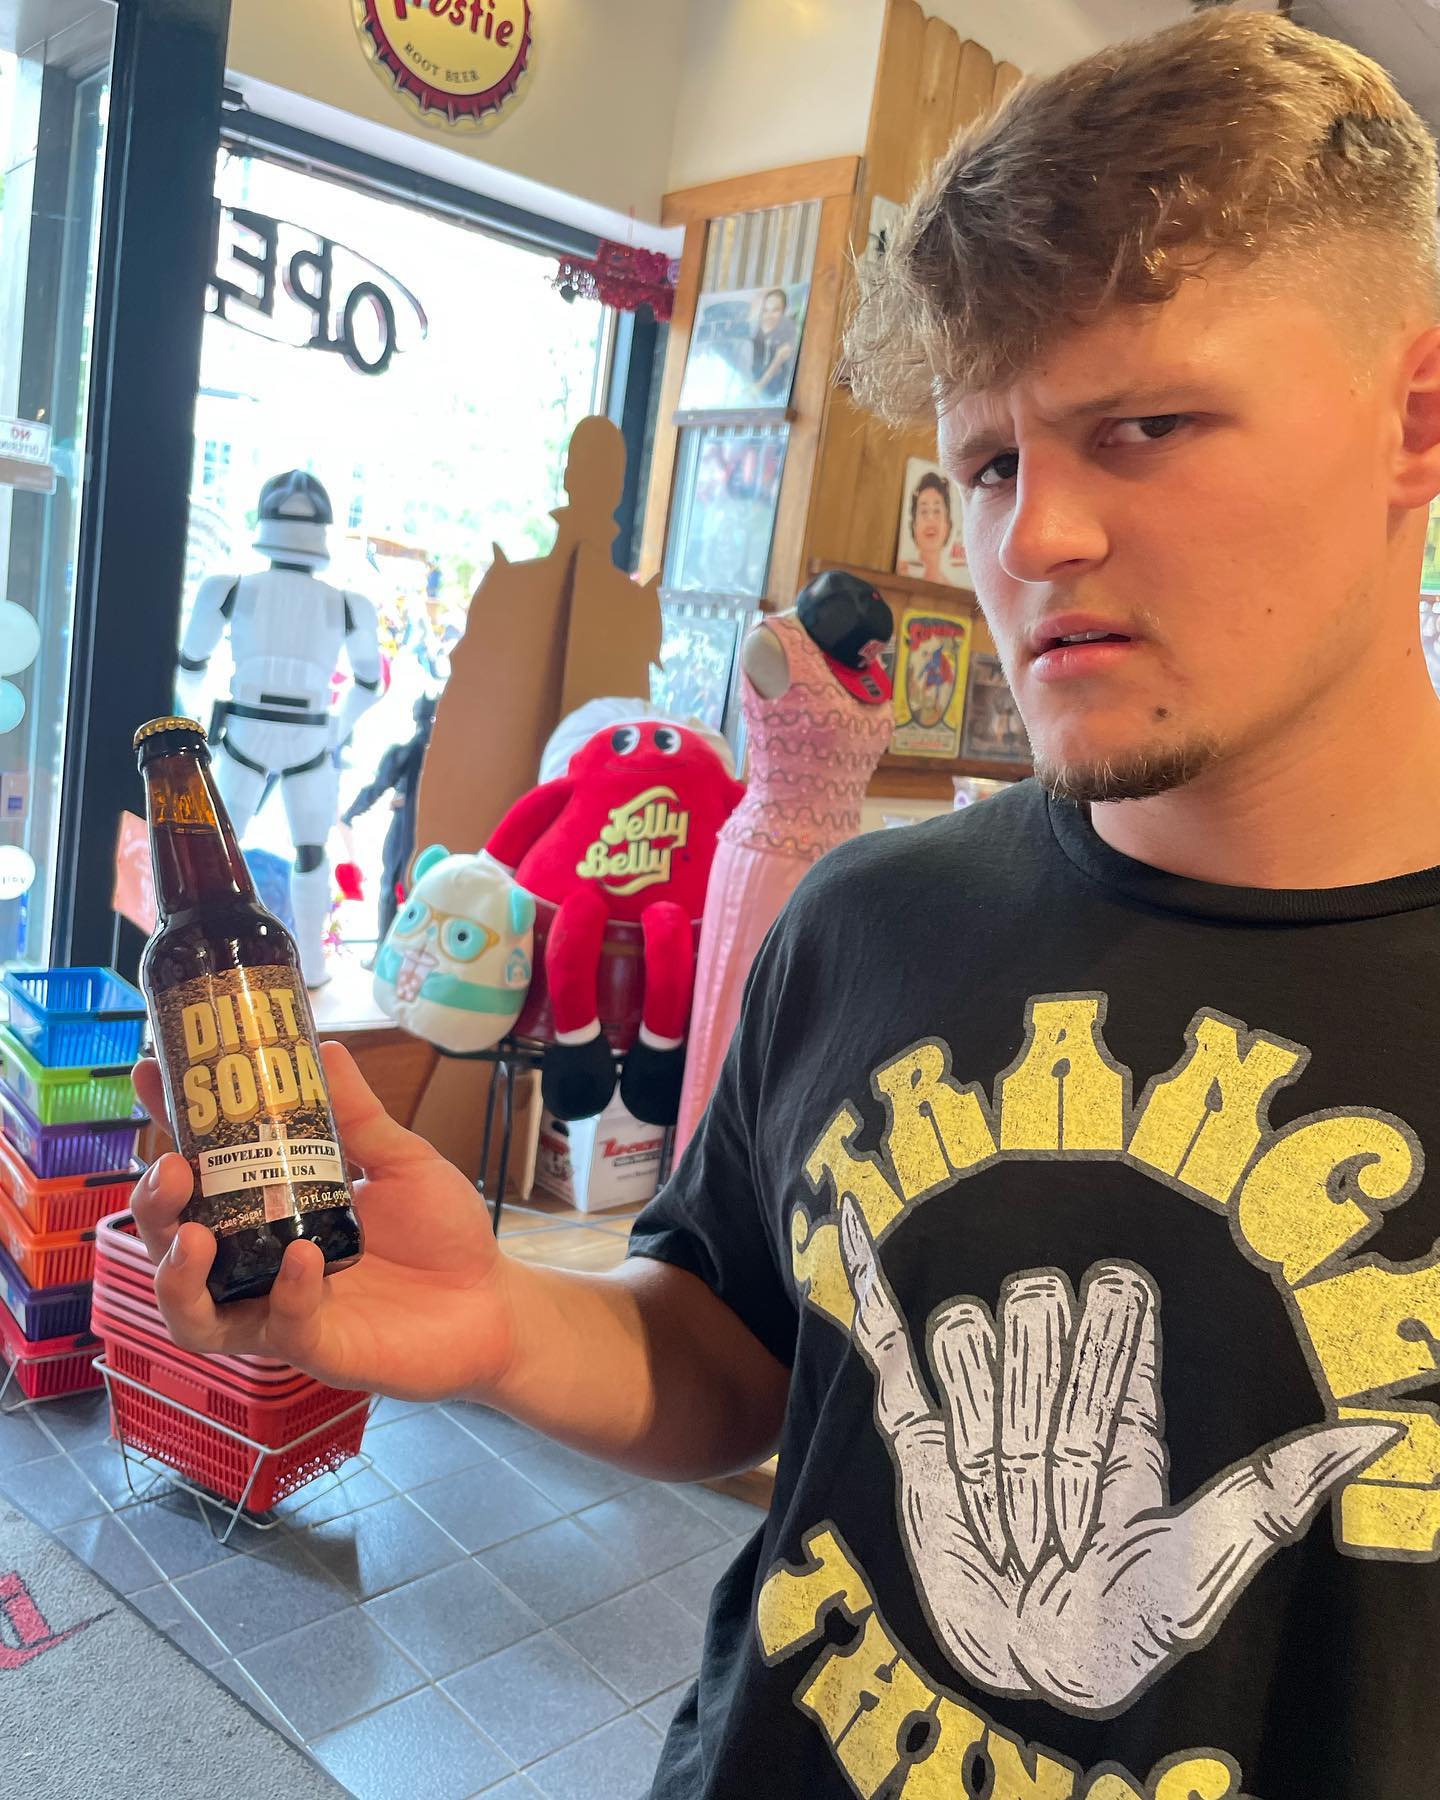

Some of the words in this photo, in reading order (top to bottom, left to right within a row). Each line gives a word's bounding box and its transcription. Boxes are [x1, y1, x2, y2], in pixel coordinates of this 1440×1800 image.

[393, 0, 514, 47] ostie
[403, 41, 440, 77] ROOT
[444, 67, 481, 84] BEER
[601, 785, 689, 848] Jelly
[576, 840, 672, 896] Belly
[182, 988, 300, 1065] DIRT
[183, 1043, 329, 1136] SODA
[207, 1147, 274, 1167] SHOVELED
[289, 1144, 336, 1157] BOTTLED
[242, 1170, 257, 1182] IN
[260, 1167, 288, 1180] THE
[291, 1165, 316, 1177] USA
[219, 1217, 239, 1230] Cane
[238, 1209, 264, 1224] Sugar
[300, 1195, 310, 1206] 12
[310, 1193, 321, 1204] FL
[321, 1191, 333, 1202] OZ
